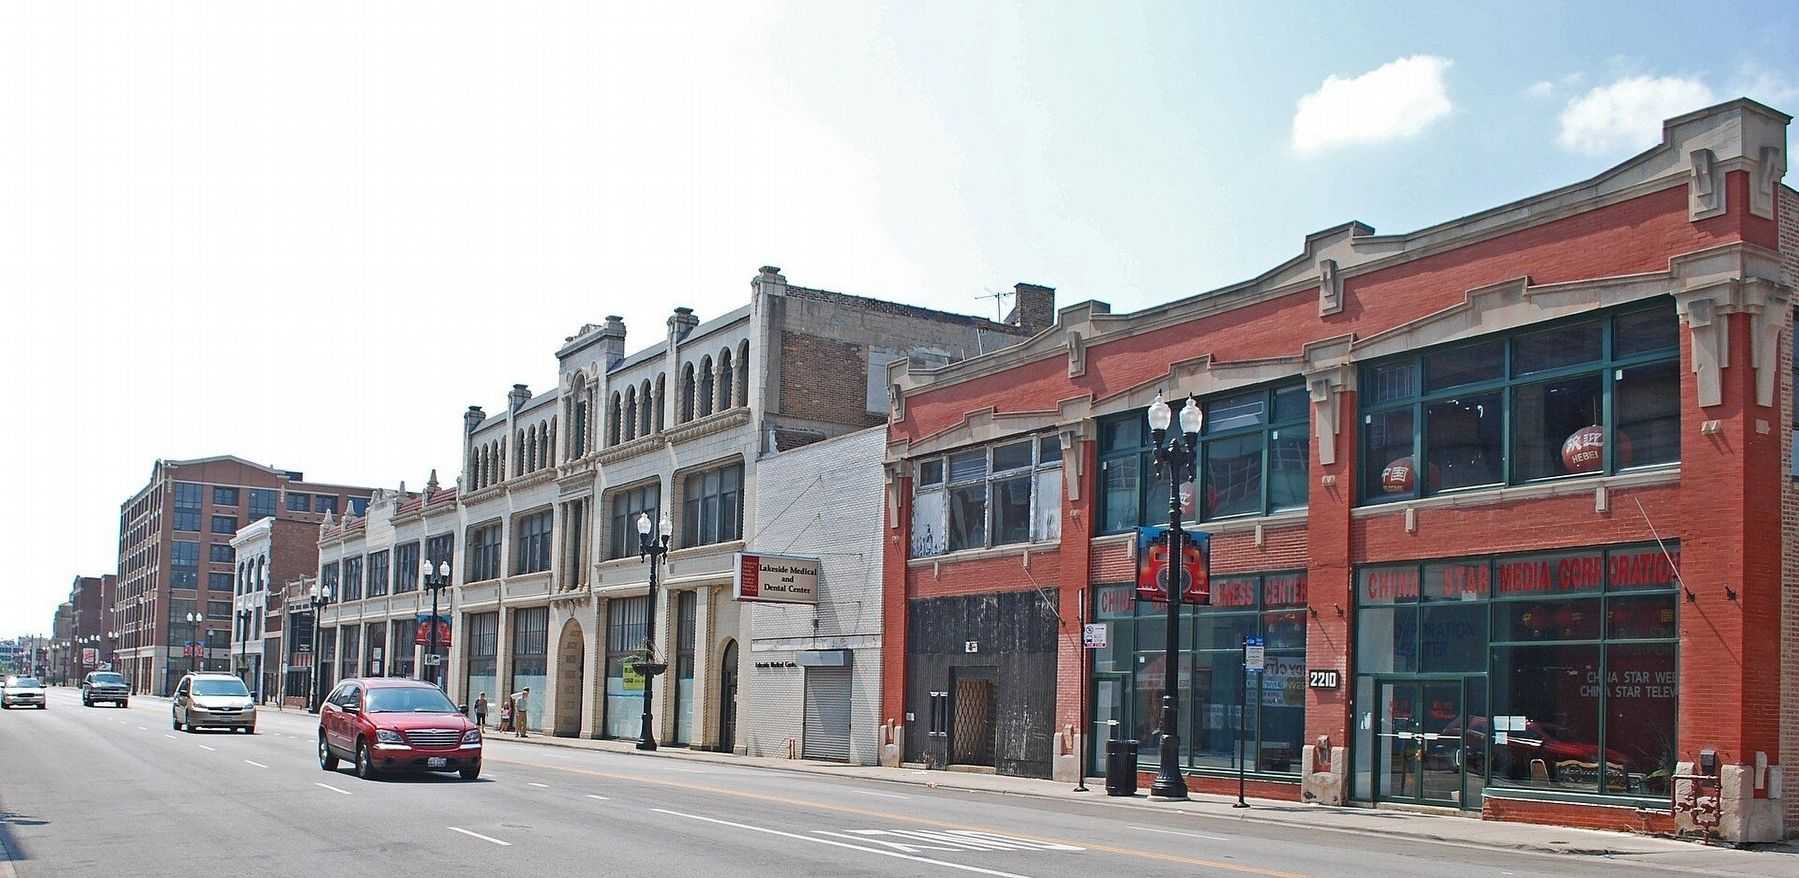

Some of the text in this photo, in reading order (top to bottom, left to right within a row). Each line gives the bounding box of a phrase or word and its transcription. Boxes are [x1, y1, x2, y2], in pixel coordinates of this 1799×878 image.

[1571, 450, 1599, 464] HEBEI
[759, 563, 817, 576] Lakeside Medical
[781, 575, 794, 583] and
[1367, 568, 1419, 599] CHINA
[1442, 562, 1489, 597] STAR
[1500, 560, 1551, 593] MEDIA
[764, 583, 811, 594] Dental Center
[1101, 589, 1135, 613] CHINA
[1264, 577, 1308, 605] CENTER
[1310, 671, 1337, 687] 2210
[1624, 671, 1649, 683] STAR
[1616, 686, 1641, 698] STAR
[809, 829, 1087, 852] ONLY
